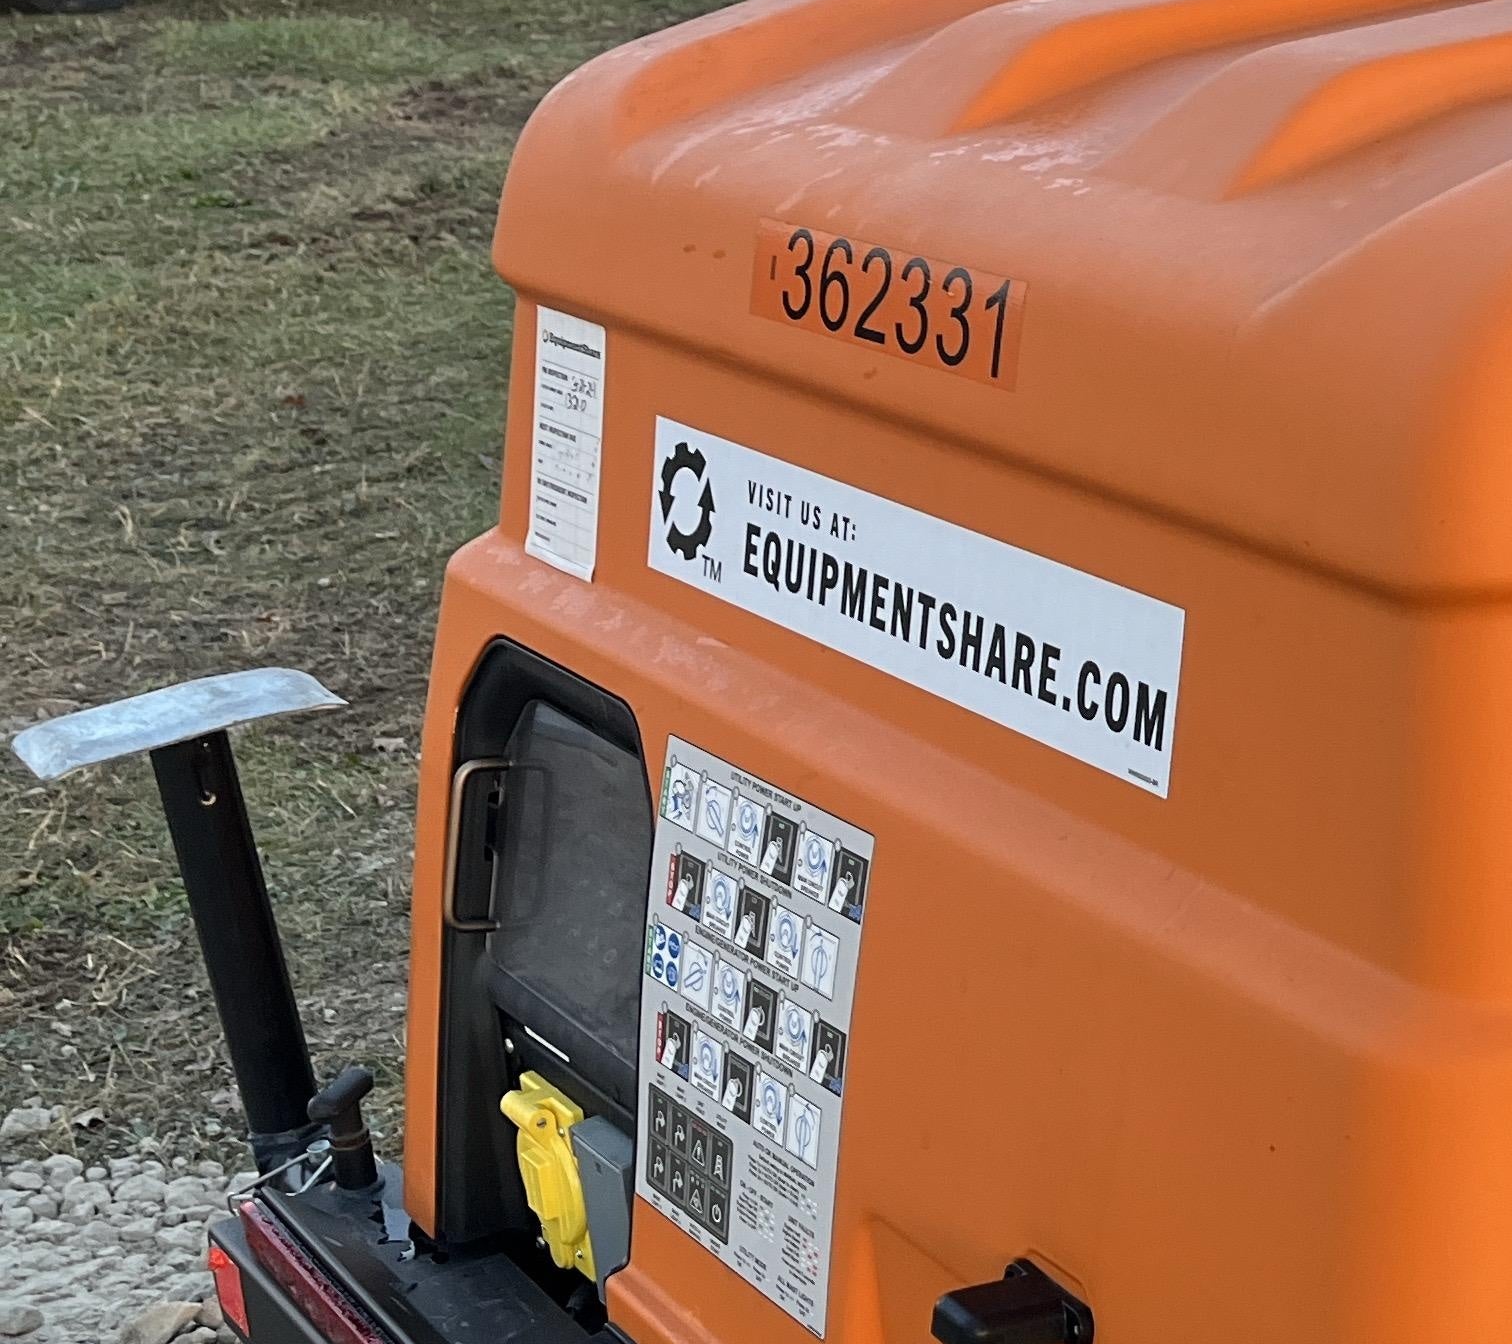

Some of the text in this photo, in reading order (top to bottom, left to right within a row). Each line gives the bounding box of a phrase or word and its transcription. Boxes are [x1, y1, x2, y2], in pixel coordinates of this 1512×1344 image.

[781, 228, 1011, 379] 362331
[747, 479, 857, 542] VISIT US AT:
[743, 521, 1168, 752] EQUIPMENTSHARE.COM
